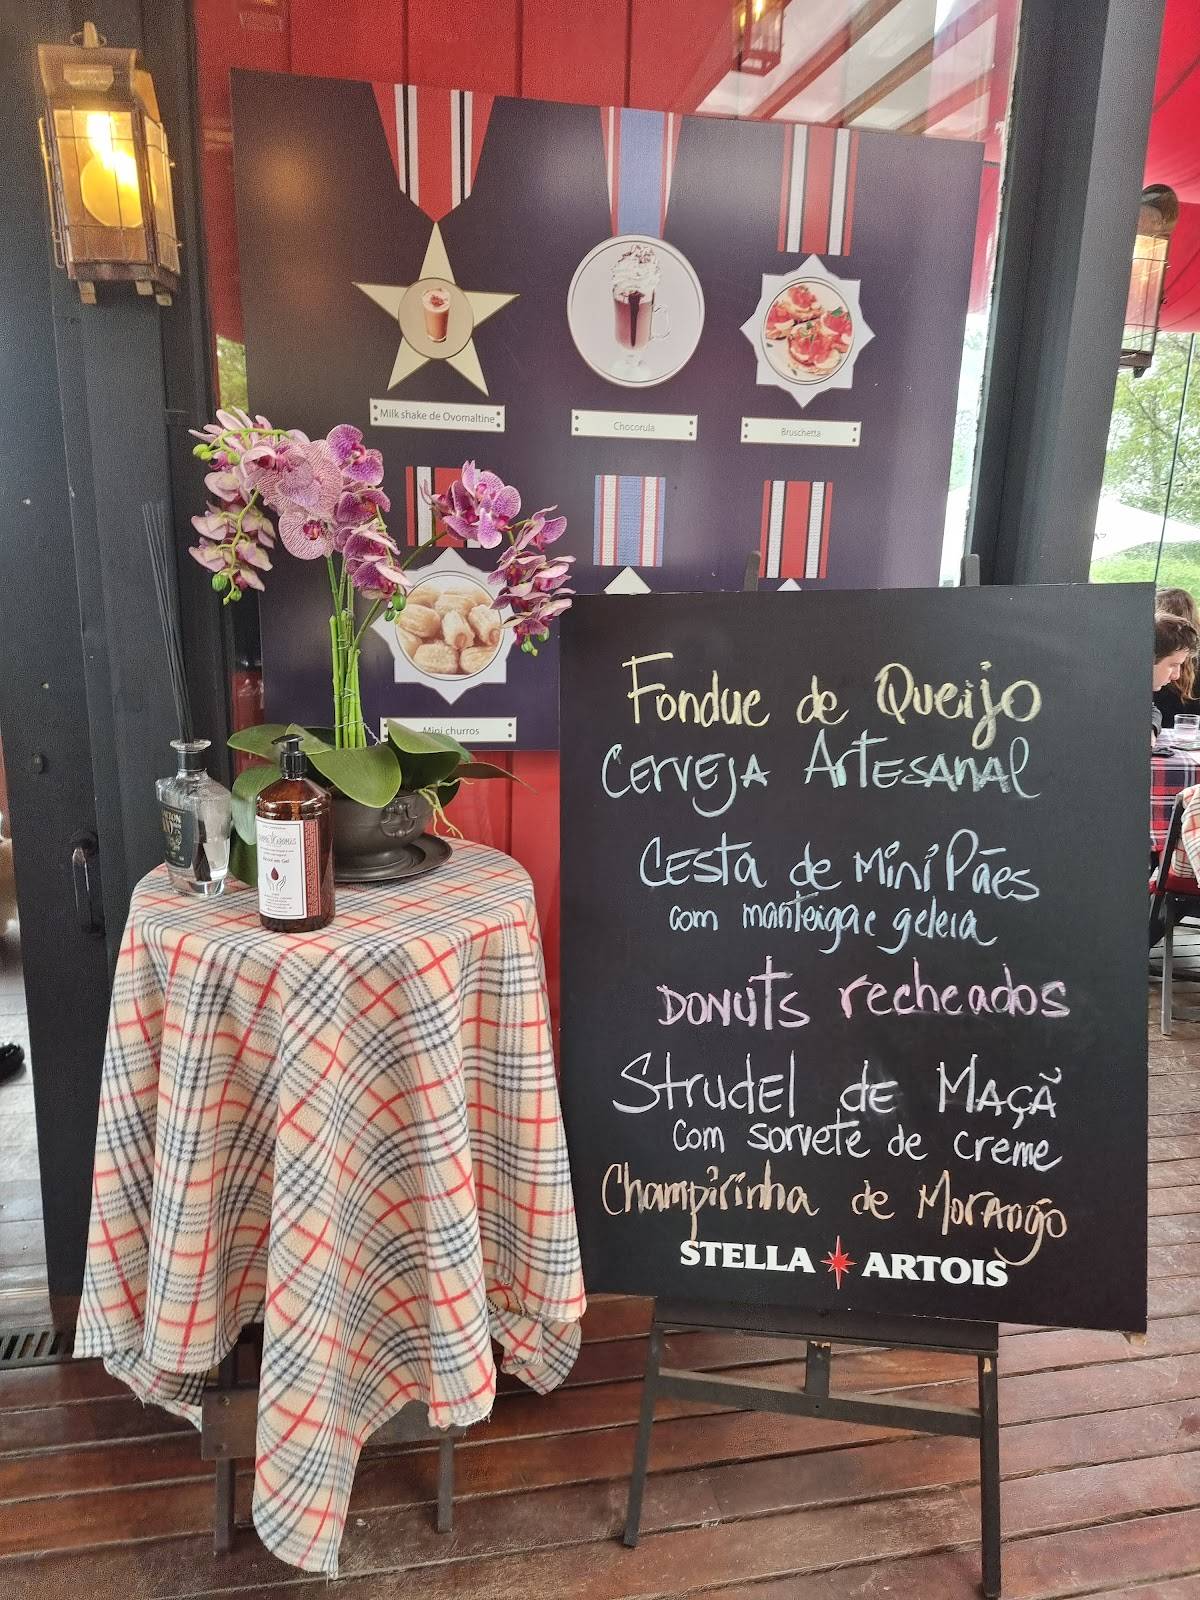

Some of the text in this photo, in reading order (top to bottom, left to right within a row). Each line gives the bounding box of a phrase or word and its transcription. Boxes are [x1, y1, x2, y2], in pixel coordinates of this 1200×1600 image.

[379, 408, 496, 424] Milk shake de Ovomaltine
[622, 652, 1041, 750] Fondue de Queijo
[445, 726, 480, 736] churros
[789, 841, 842, 890] de
[853, 840, 939, 891] Mini
[945, 829, 1040, 901] Pães
[669, 905, 718, 931] com
[876, 896, 998, 953] geleia
[839, 957, 1070, 1020] recheados
[746, 1109, 871, 1158] sorvete
[887, 1124, 928, 1160] de
[953, 1131, 1063, 1172] creme
[851, 1180, 895, 1220] de
[680, 1240, 1008, 1287] STELLA ARTOIS
